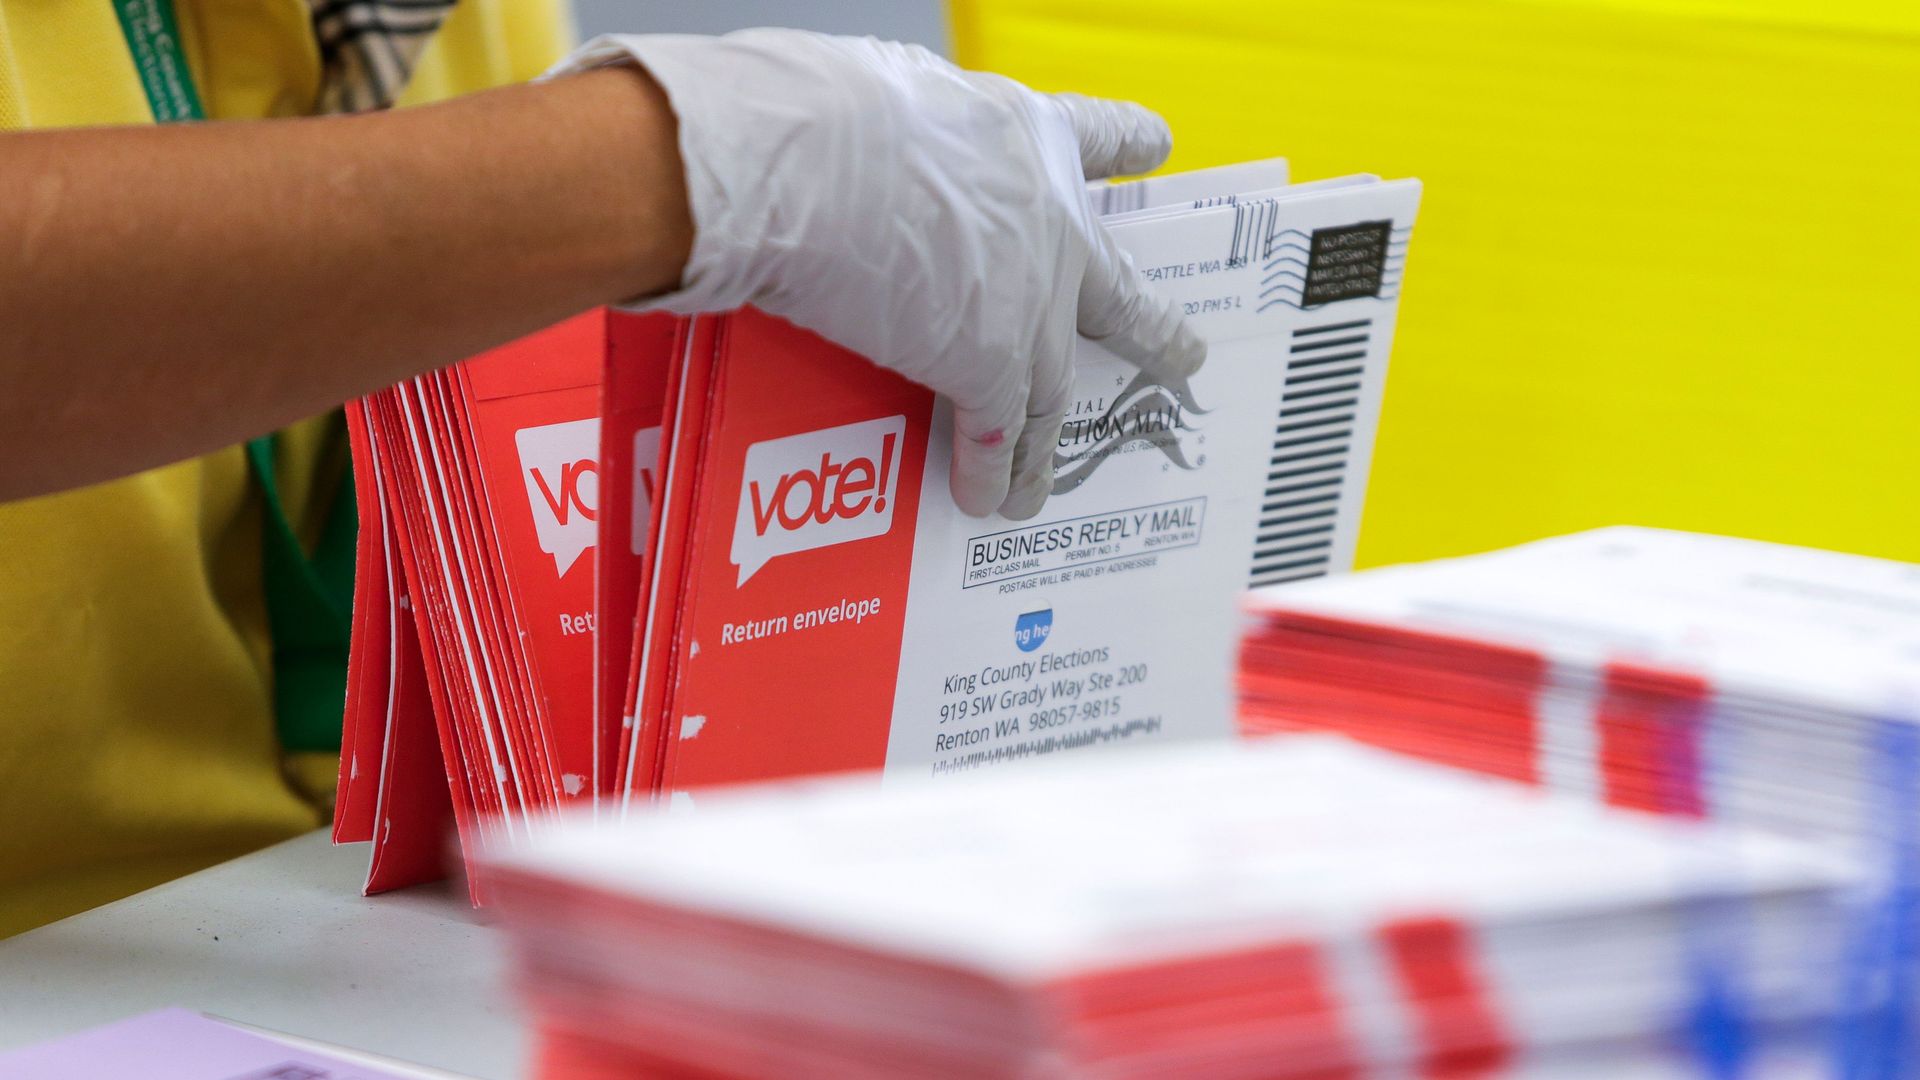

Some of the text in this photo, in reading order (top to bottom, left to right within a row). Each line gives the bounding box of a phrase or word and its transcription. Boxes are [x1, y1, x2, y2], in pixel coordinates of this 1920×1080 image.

[1141, 262, 1195, 281] EATTLE
[1199, 259, 1220, 273] WA
[1202, 298, 1221, 312] PM
[1223, 296, 1232, 310] 5
[1132, 403, 1182, 436] MAIL
[749, 432, 897, 537] vote!
[969, 563, 1021, 581] FIRST-CLASS
[1022, 558, 1040, 570] MAIL
[1065, 547, 1096, 561] PERMIT
[1144, 534, 1178, 547] RENTON
[972, 505, 1197, 567] BUSINESS REPLY MAIL
[999, 556, 1158, 595] POSTAGE WILL BE PAID BY ADDRESSEE
[721, 597, 881, 646] Return envelope
[939, 663, 1148, 724] 919 SW Grady Way Ste 200
[944, 646, 1109, 695] King County Elections
[936, 695, 1121, 752] Renton WA 98057-9815
